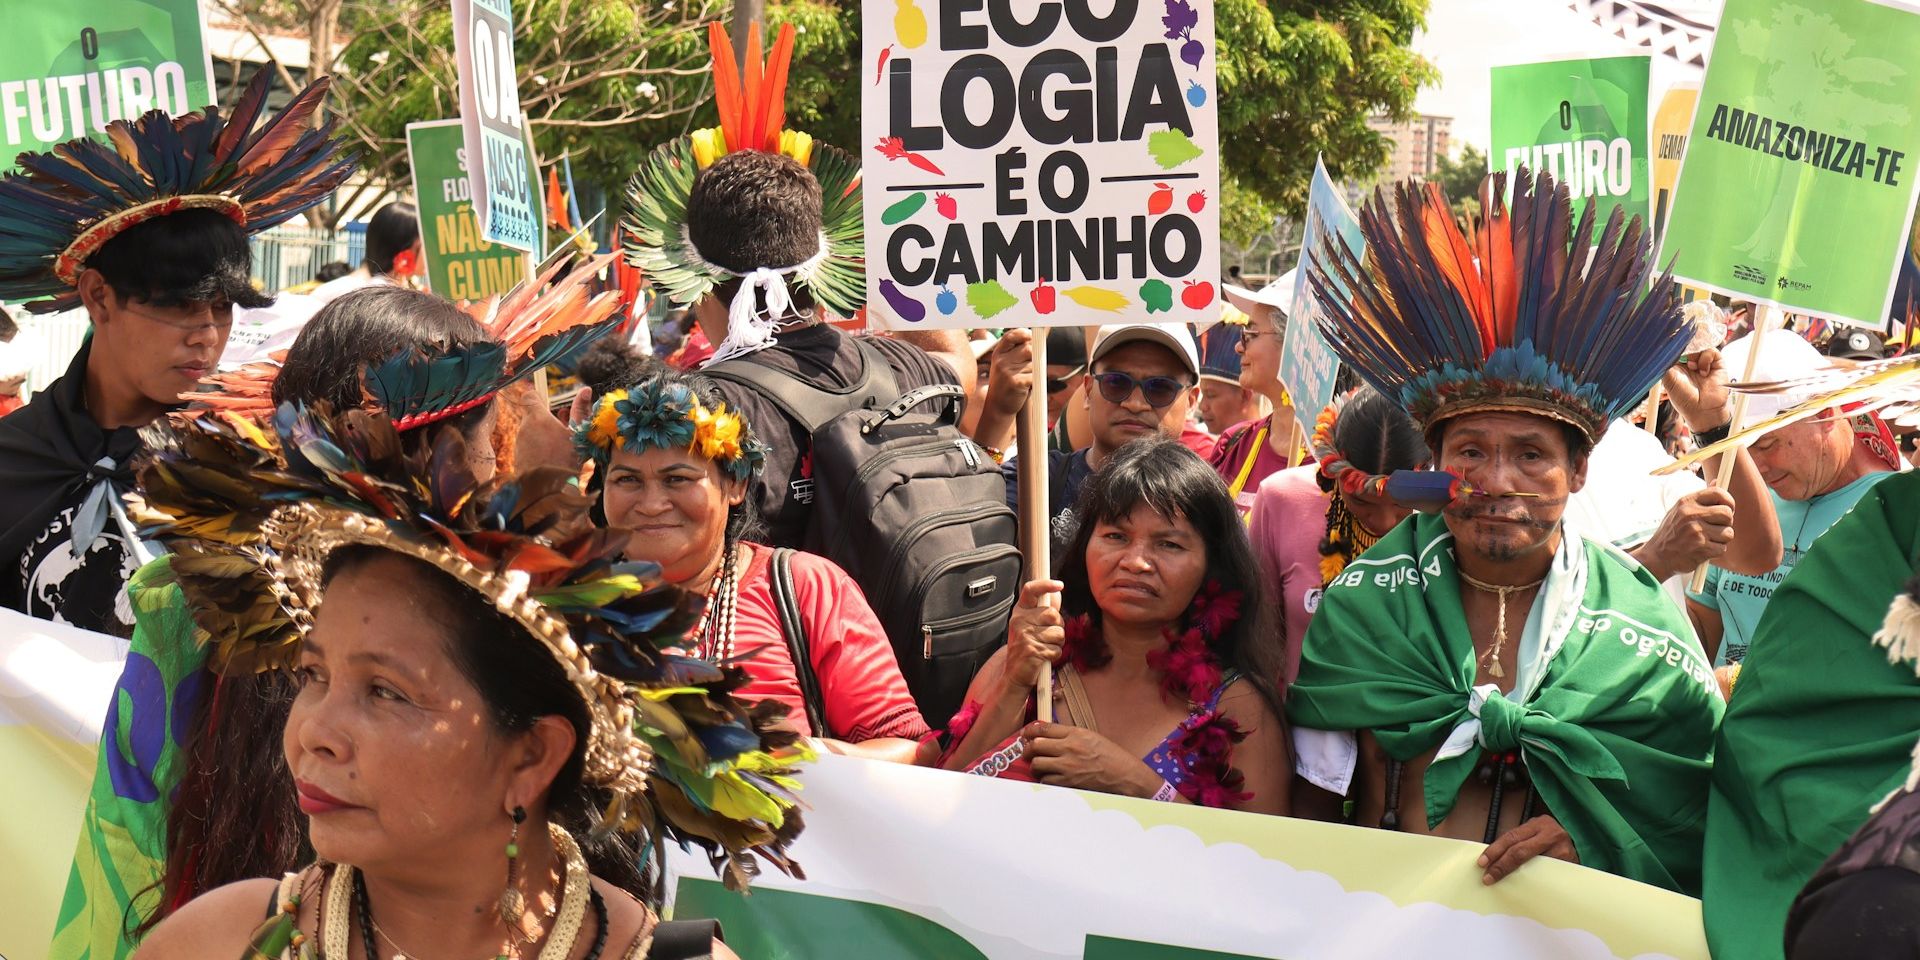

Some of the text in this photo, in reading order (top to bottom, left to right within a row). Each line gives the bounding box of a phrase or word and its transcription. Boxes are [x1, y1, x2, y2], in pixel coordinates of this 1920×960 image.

[80, 27, 98, 60] O
[1, 61, 189, 145] FUTURO
[889, 43, 1194, 151] LOGIA
[1560, 101, 1571, 130] O
[1706, 104, 1906, 187] AMAZONIZA-TE
[996, 147, 1089, 215] É O
[886, 213, 1202, 286] CAMINHO
[1731, 581, 1745, 594] DE
